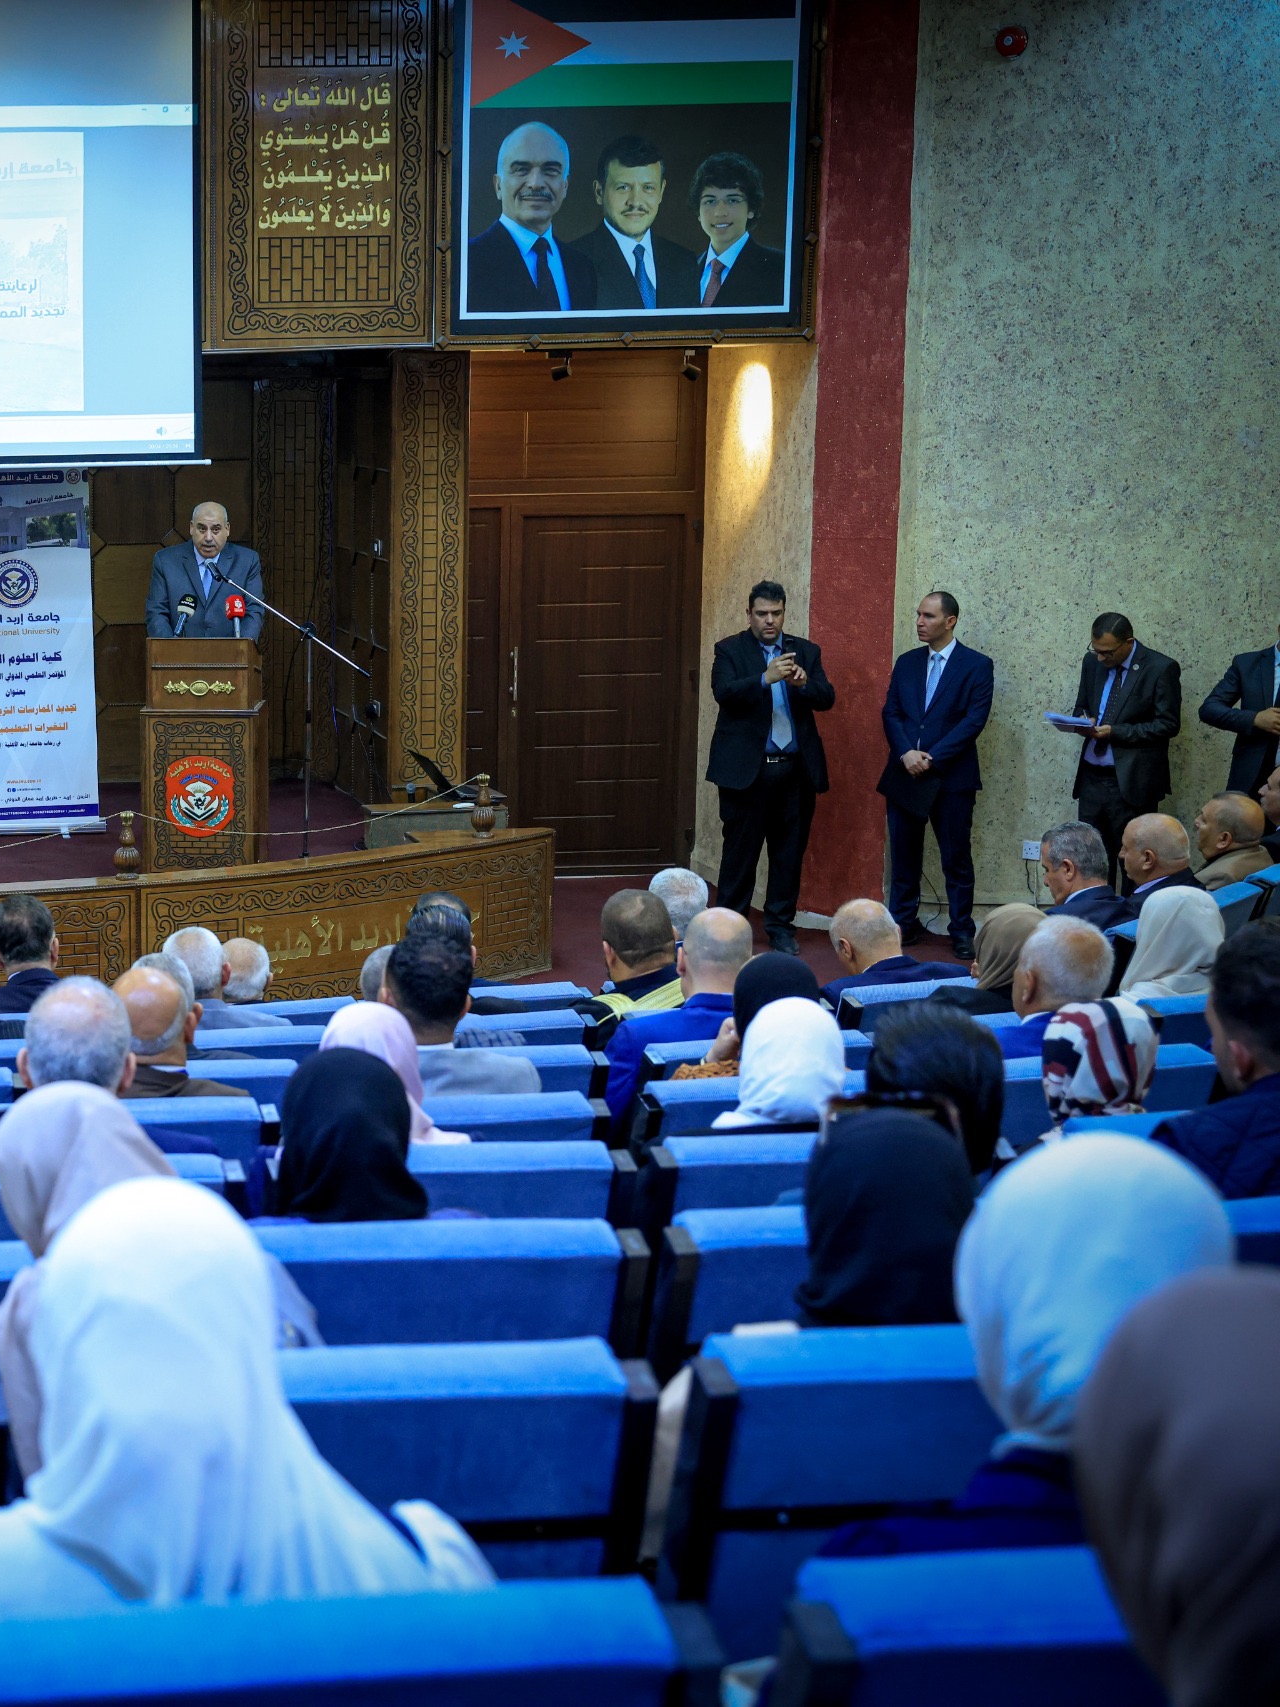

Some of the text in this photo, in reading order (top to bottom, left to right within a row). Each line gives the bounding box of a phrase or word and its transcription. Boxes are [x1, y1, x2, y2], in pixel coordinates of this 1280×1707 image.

[31, 306, 66, 319] تجديد
[6, 613, 24, 625] إربد
[27, 612, 60, 624] جامعة
[22, 627, 61, 636] University
[8, 652, 39, 667] العلوم
[41, 651, 63, 665] كلية
[17, 703, 54, 716] الممارسات
[55, 703, 77, 714] تجديد
